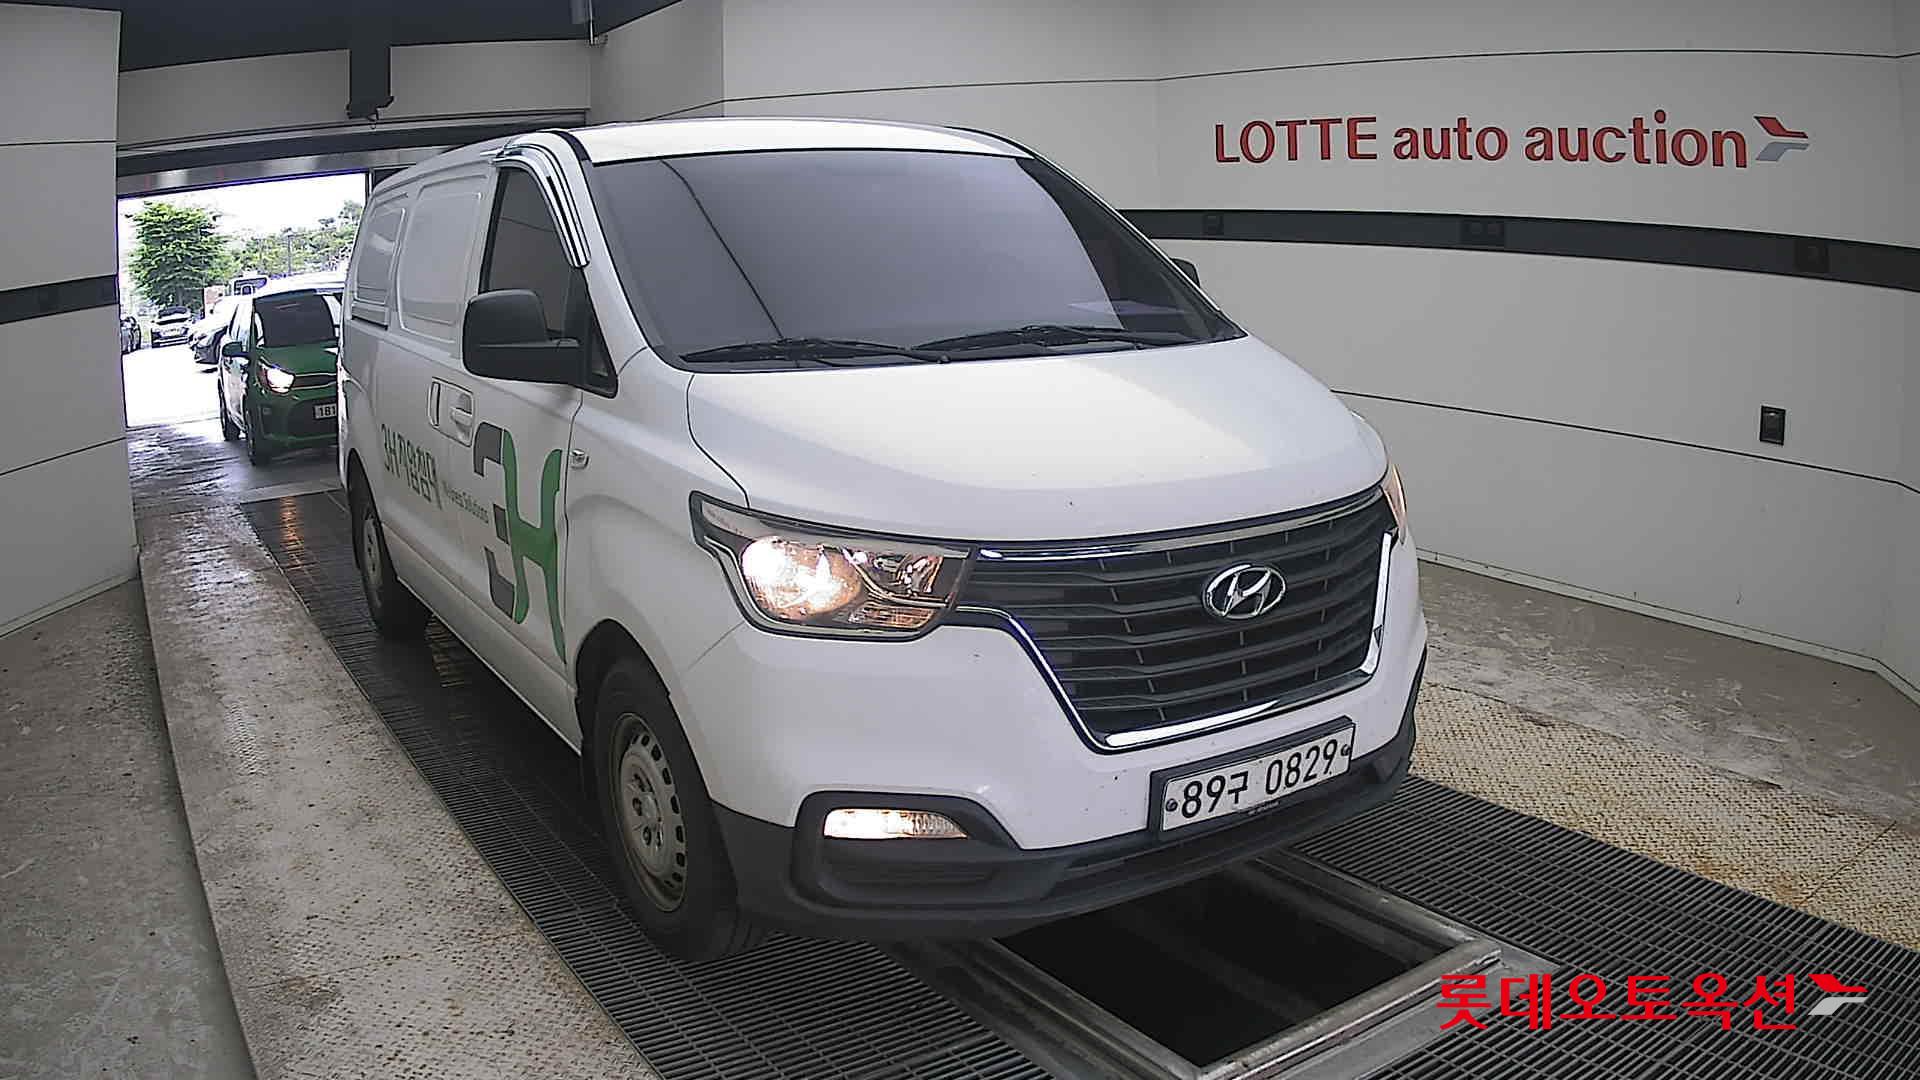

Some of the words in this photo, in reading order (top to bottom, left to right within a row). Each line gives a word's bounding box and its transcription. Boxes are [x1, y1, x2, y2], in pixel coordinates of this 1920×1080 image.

[1215, 117, 1378, 163] LOTTE
[1393, 117, 1509, 162] auto
[1524, 109, 1749, 168] auction
[1181, 770, 1249, 818] 89구
[1265, 739, 1338, 795] 0829
